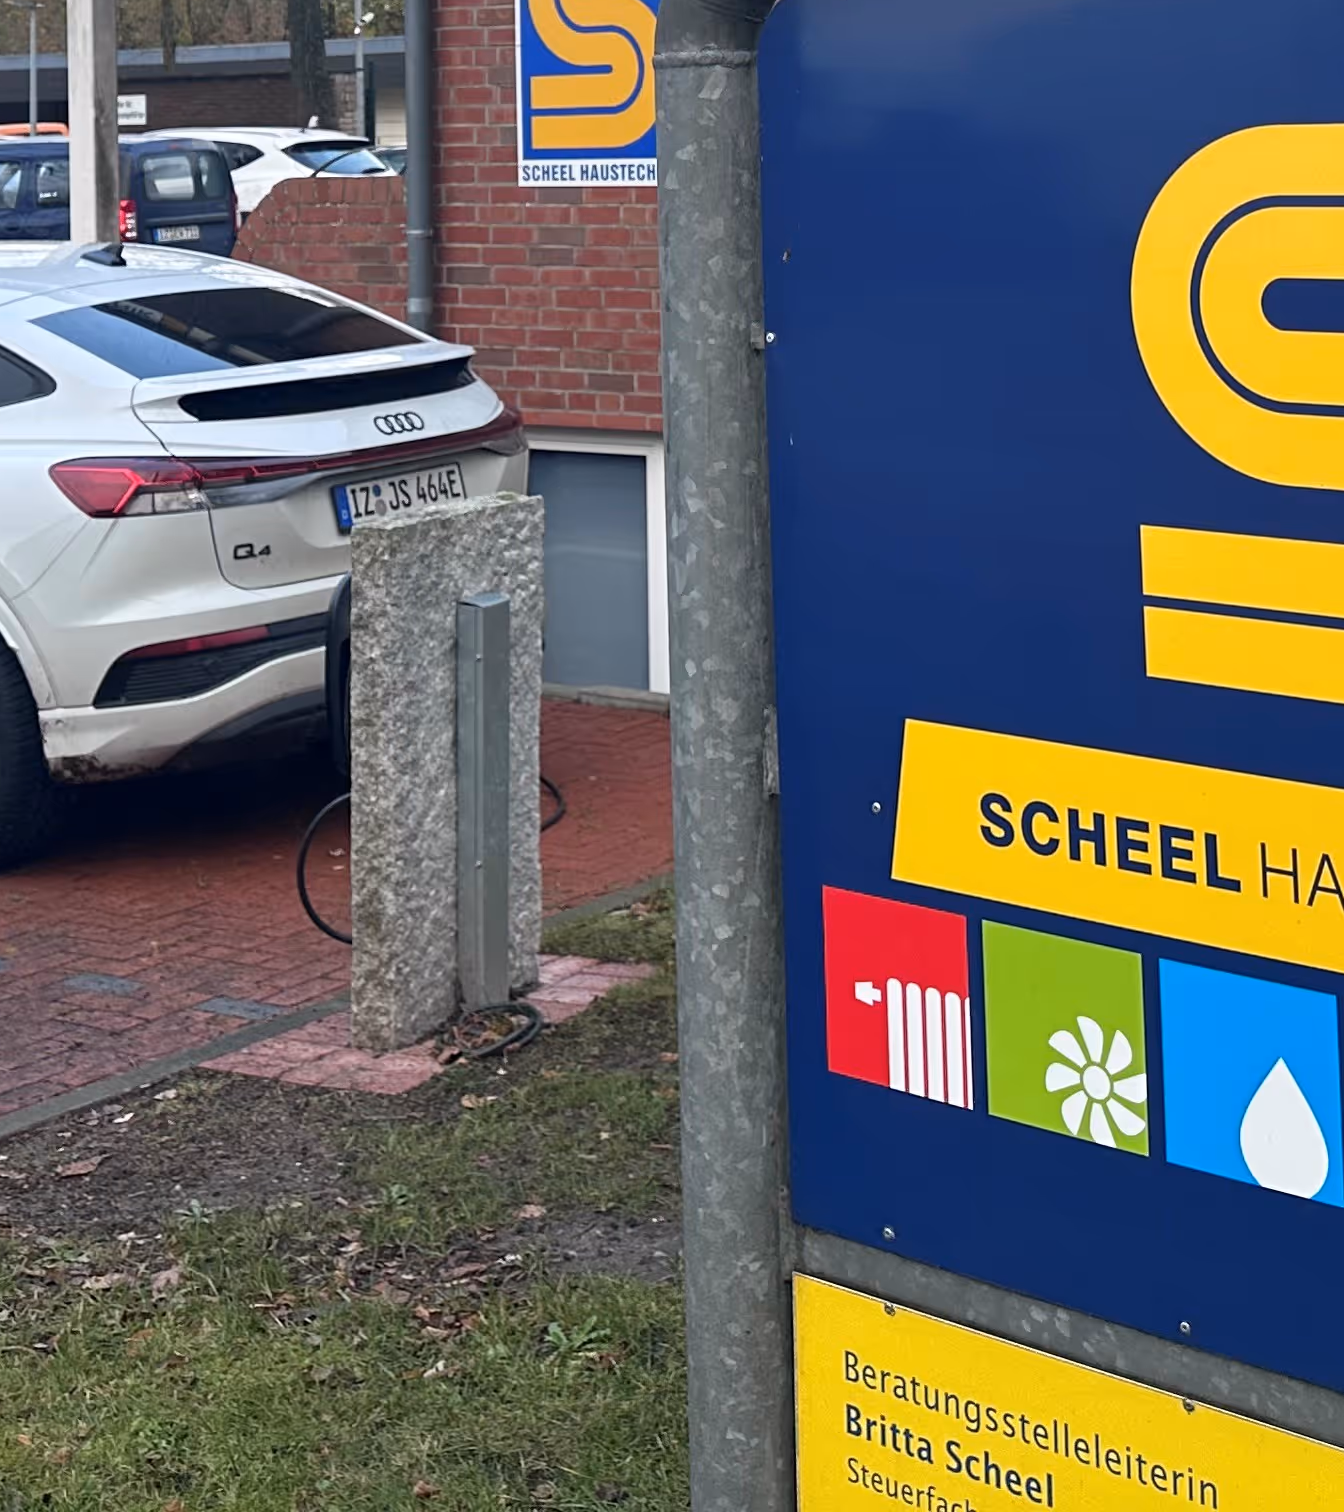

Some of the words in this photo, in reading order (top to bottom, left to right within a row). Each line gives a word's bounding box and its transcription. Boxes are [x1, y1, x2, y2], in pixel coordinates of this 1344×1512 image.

[522, 164, 575, 182] SCHEEL
[350, 486, 375, 518] IZ
[389, 479, 412, 510] JS
[233, 542, 271, 560] Q4
[979, 792, 1242, 892] SCHEEL
[844, 1350, 1218, 1509] Beratungsstelleleiterin
[846, 1404, 933, 1464] Britta
[946, 1440, 1054, 1508] Scheel
